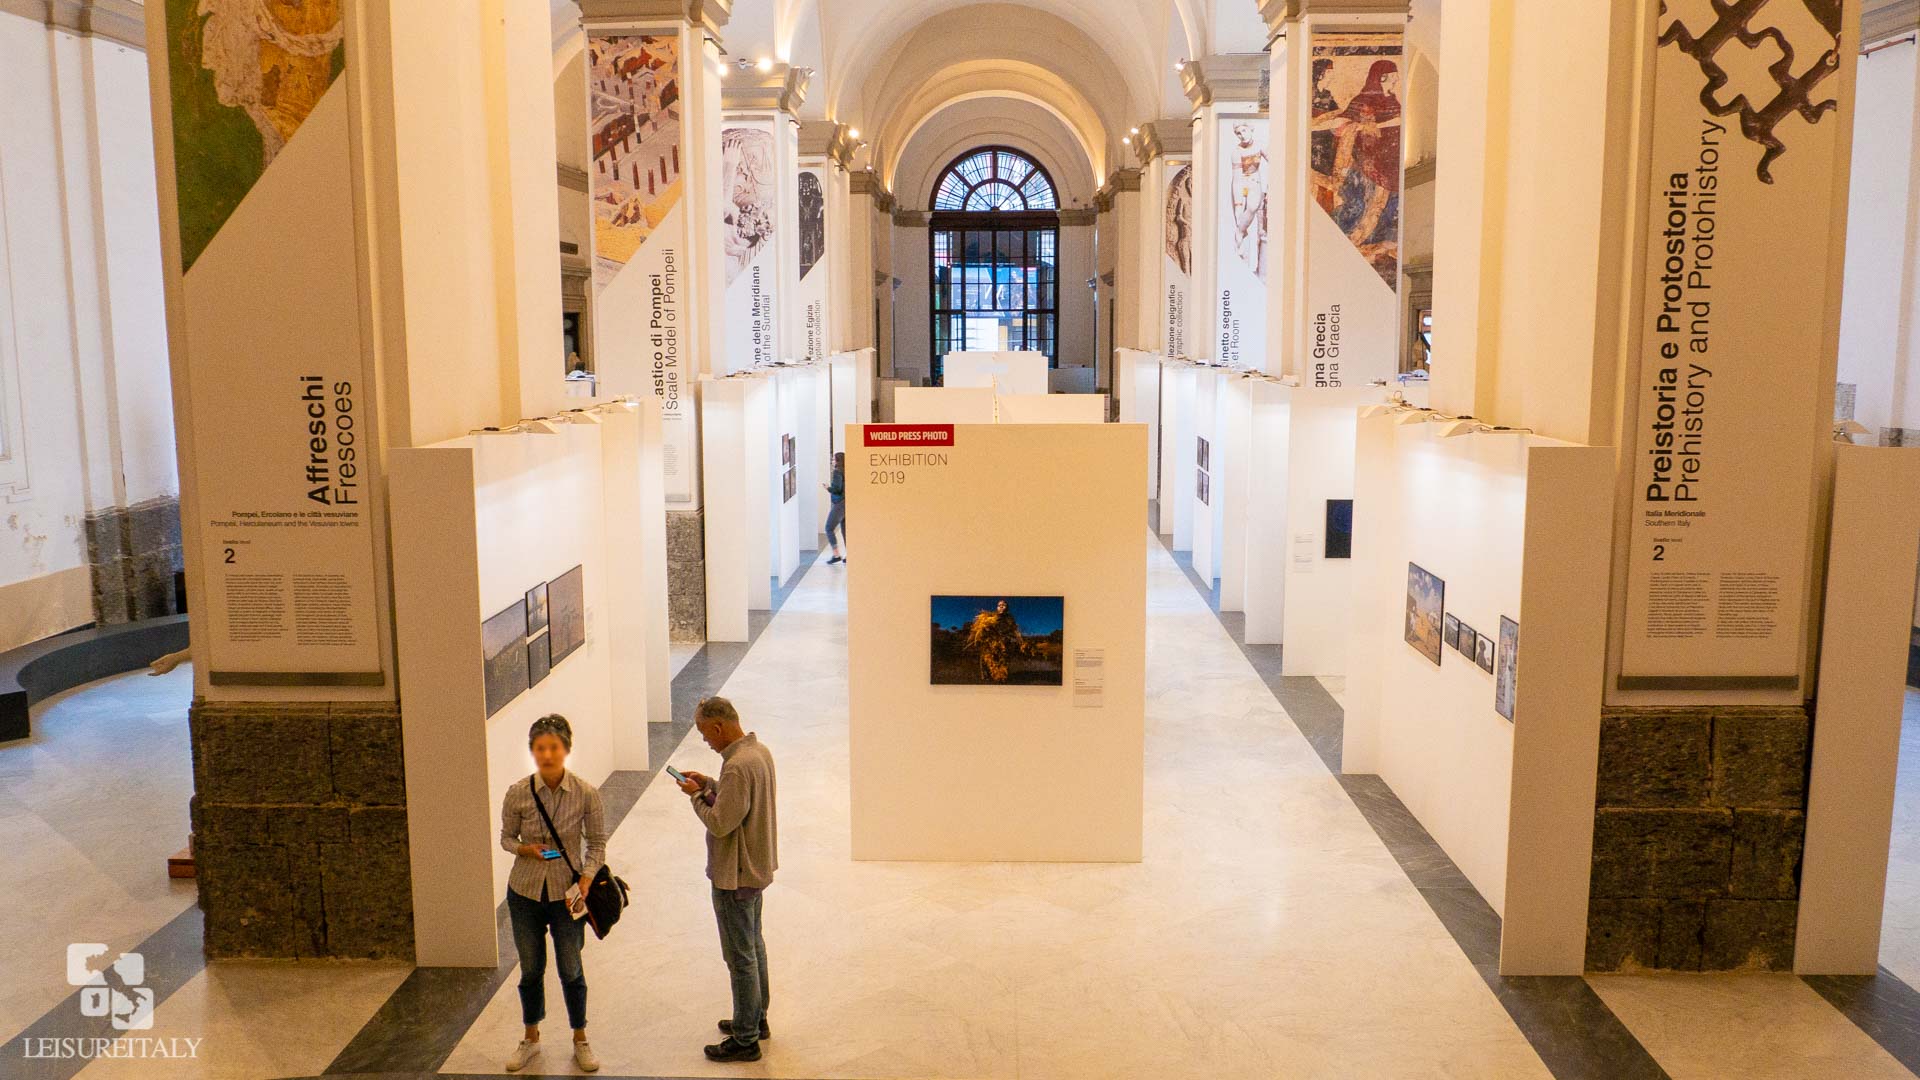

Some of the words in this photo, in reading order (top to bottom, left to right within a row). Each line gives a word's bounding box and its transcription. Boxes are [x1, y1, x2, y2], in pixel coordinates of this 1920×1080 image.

[1687, 119, 1727, 290] Protohistory
[1656, 172, 1689, 333] Protostoria
[661, 248, 677, 304] Pompeii
[751, 265, 761, 317] Meridiana
[648, 274, 664, 329] Pompei
[664, 308, 676, 322] of
[761, 294, 771, 332] Sundial
[1168, 284, 1177, 325] epigrafica
[1222, 290, 1232, 329] segreto
[650, 334, 663, 348] di
[664, 326, 677, 368] Model
[752, 320, 761, 345] della
[762, 334, 771, 350] the
[1231, 319, 1240, 349] Room
[1312, 313, 1326, 359] Grecia
[1327, 304, 1340, 358] Graecia
[1686, 301, 1710, 354] and
[762, 353, 771, 362] of
[1660, 342, 1679, 360] e
[652, 352, 665, 399] astico
[665, 372, 678, 410] Scale
[1315, 363, 1328, 388] gna
[300, 375, 331, 506] Affreschi
[334, 380, 358, 505] Frescoes
[870, 431, 897, 441] WORLD
[898, 431, 921, 441] PRESS
[922, 431, 948, 440] PHOTO
[1646, 367, 1678, 502] Preistoria
[1674, 363, 1713, 502] Prehistory
[870, 453, 948, 466] EXHIBITION
[870, 470, 905, 485] 2019
[224, 548, 236, 564] 2
[1652, 545, 1665, 561] 2
